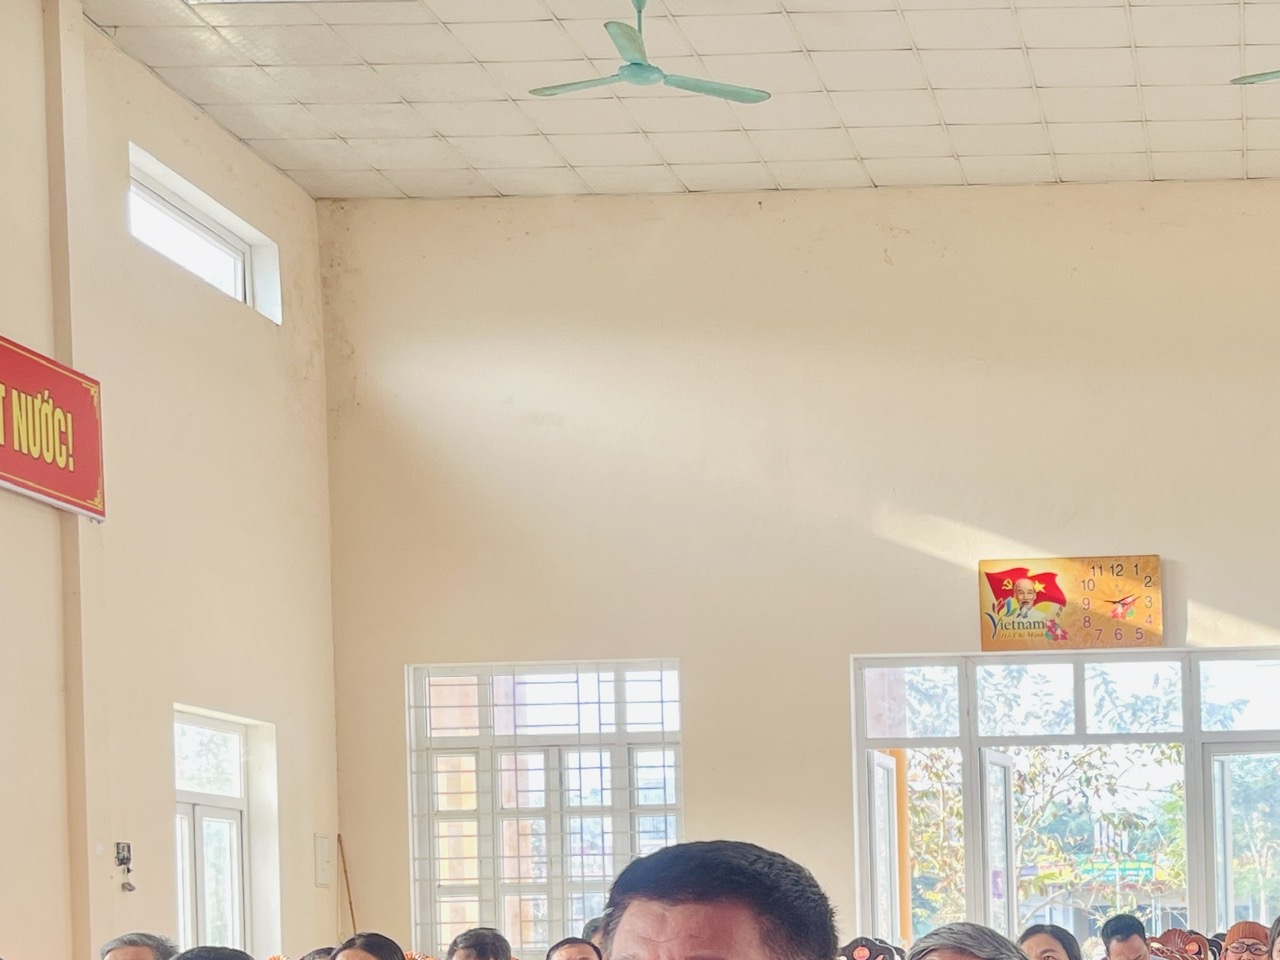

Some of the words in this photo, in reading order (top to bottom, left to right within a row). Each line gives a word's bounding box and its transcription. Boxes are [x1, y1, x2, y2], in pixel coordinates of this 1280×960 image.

[11, 388, 75, 472] NƯỚC!
[1090, 563, 1103, 577] 11
[1110, 563, 1124, 577] 12
[1133, 562, 1139, 576] 1
[1081, 578, 1096, 592] 10
[1143, 575, 1153, 588] 2
[1082, 597, 1090, 611] 9
[1144, 595, 1153, 609] 3
[984, 612, 1045, 640] Vietnam
[1083, 615, 1092, 629] 8
[1145, 613, 1153, 626] 4
[1095, 628, 1103, 641] 7
[1114, 628, 1123, 641] 6
[1135, 627, 1144, 640] 5
